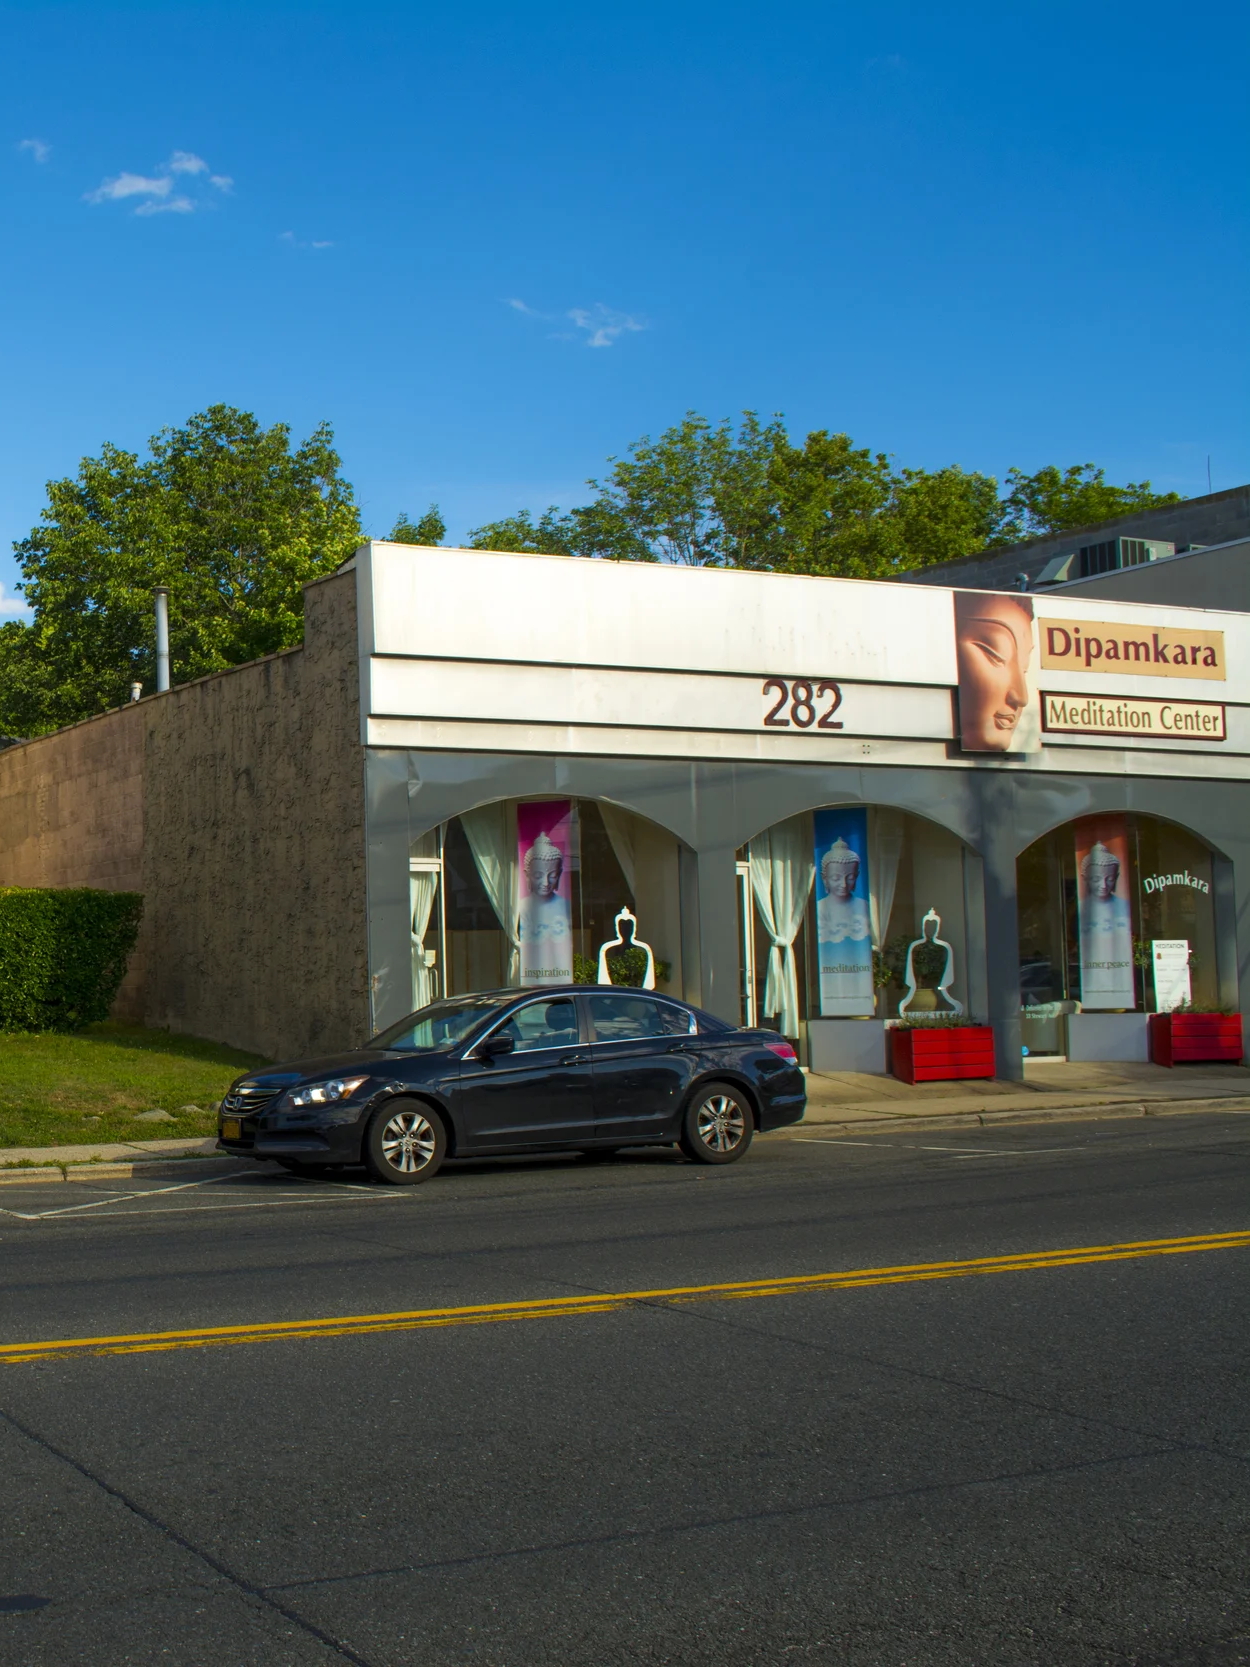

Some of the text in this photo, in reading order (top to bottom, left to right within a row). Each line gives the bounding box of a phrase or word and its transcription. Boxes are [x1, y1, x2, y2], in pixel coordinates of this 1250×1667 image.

[1046, 627, 1218, 667] Dipamkara
[762, 679, 843, 729] 282
[1050, 700, 1219, 732] Meditation Center
[1144, 870, 1210, 894] Dipamkara
[525, 968, 570, 979] inspiration
[822, 963, 870, 973] meditation
[1084, 960, 1130, 970] inner peace
